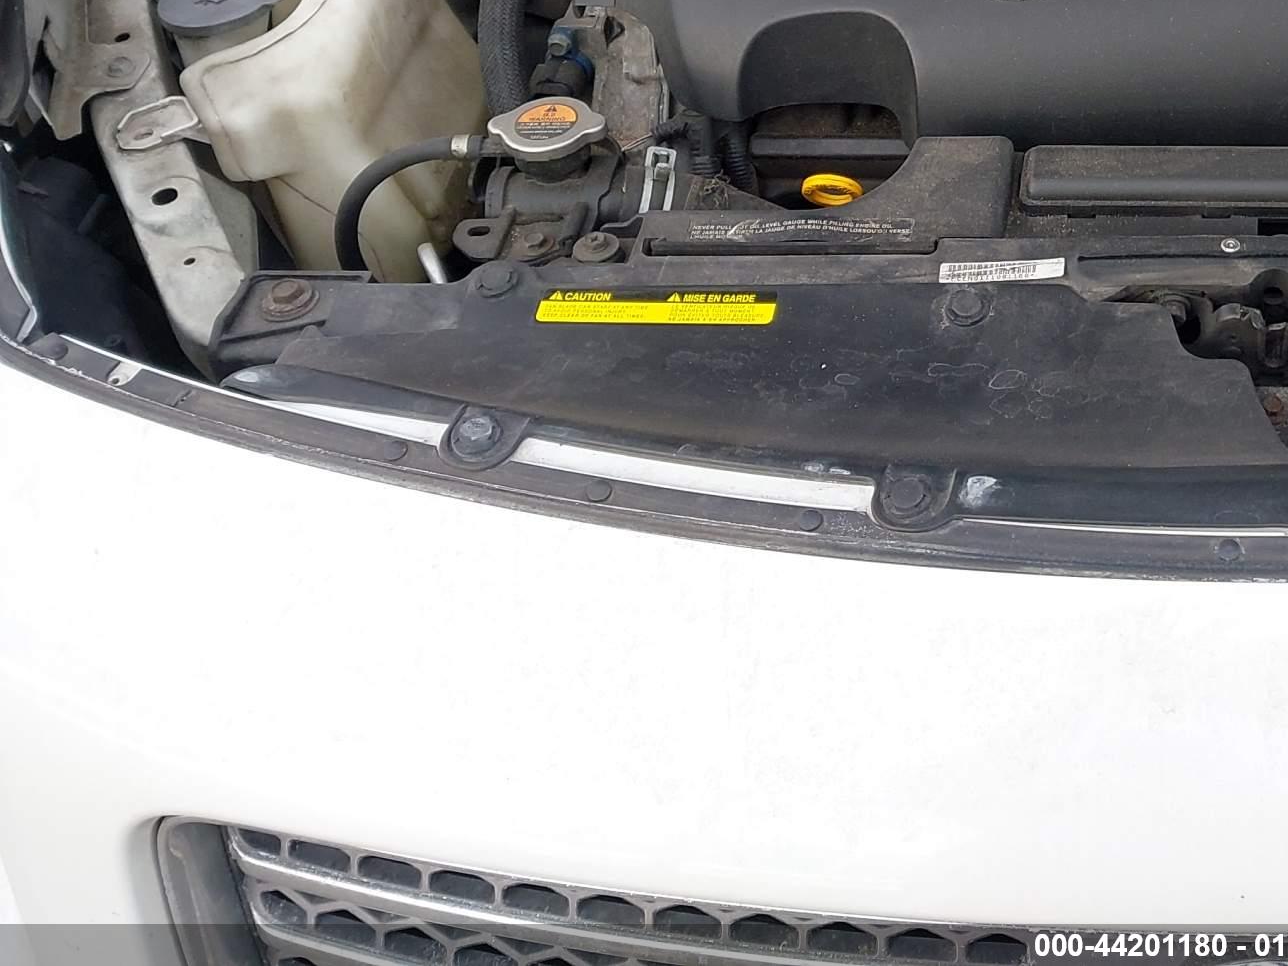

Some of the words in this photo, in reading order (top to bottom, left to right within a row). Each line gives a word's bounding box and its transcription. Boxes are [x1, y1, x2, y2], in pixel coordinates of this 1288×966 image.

[564, 292, 612, 301] CAUTION
[682, 293, 707, 303] MISE
[707, 294, 722, 303] EN
[722, 294, 757, 304] GARDE
